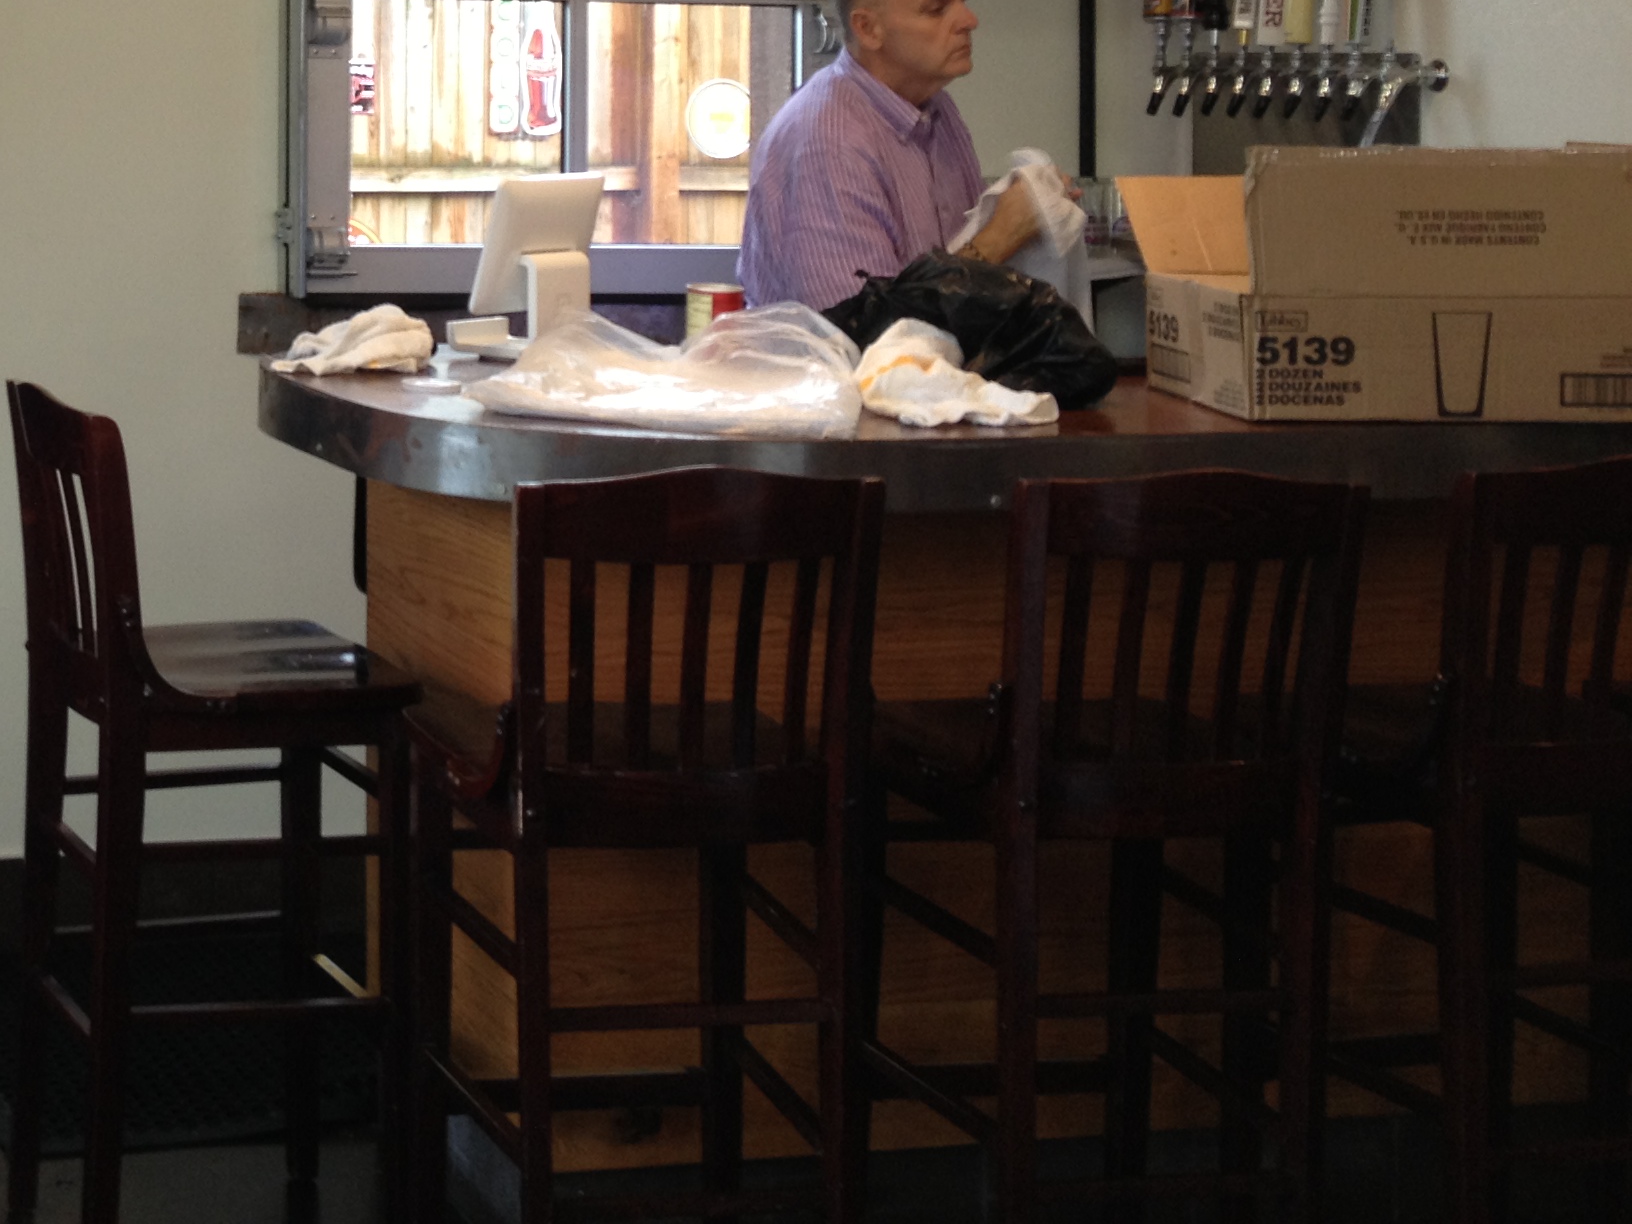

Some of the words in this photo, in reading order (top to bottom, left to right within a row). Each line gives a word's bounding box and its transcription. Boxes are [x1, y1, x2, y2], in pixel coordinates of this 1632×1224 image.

[1256, 335, 1356, 367] 5139
[1269, 368, 1324, 380] DOZEN
[1269, 380, 1362, 394] DOUZAINES
[1269, 393, 1346, 407] DOCENAS
